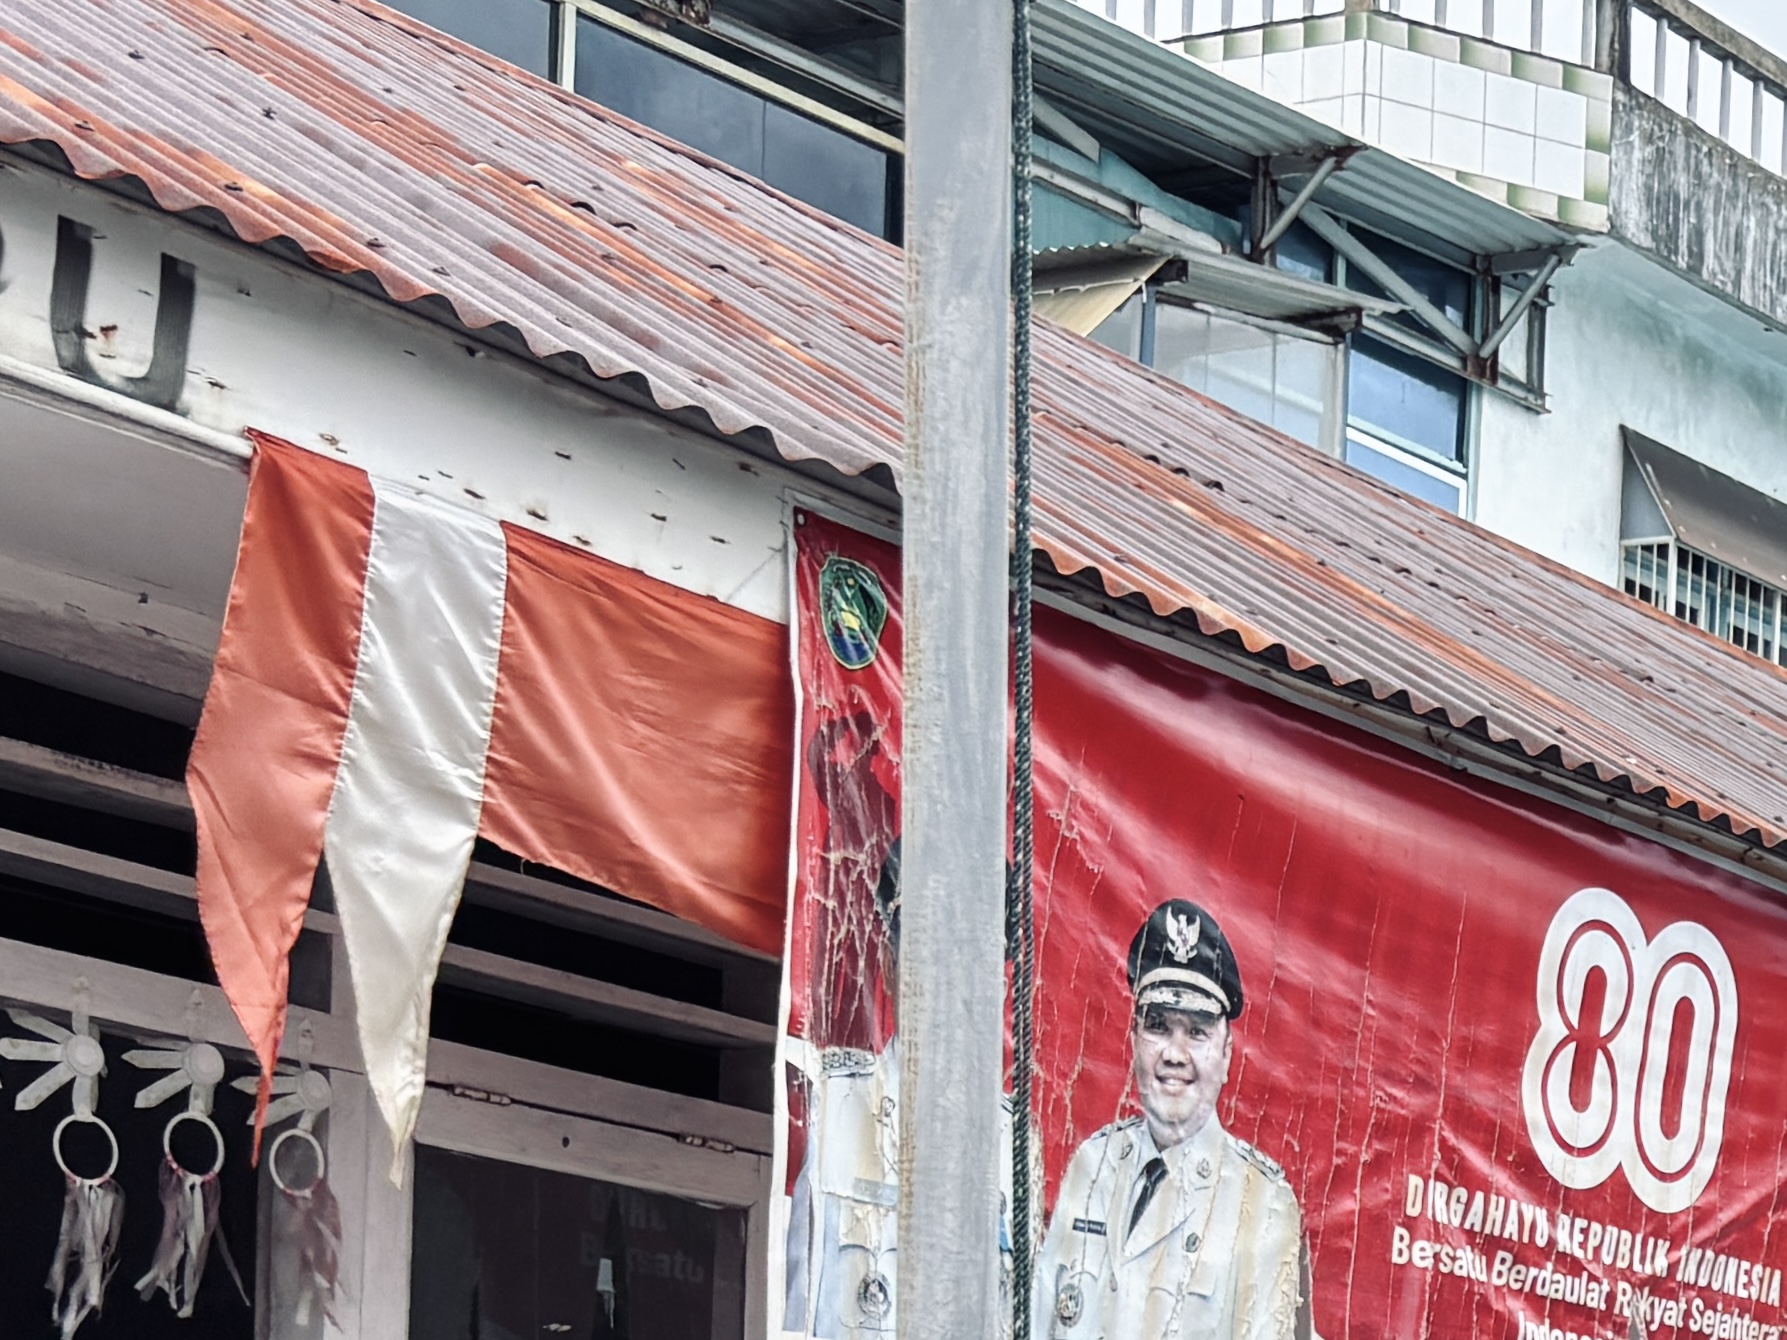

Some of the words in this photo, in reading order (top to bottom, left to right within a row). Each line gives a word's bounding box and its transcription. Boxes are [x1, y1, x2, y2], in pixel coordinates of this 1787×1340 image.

[0, 213, 197, 419] U
[1521, 887, 1739, 1213] 80
[1391, 1226, 1488, 1282] Bersatu
[1492, 1250, 1611, 1312] Berdaulat
[1405, 1173, 1549, 1248] DIRGAHAYU
[1556, 1214, 1671, 1277] REPUBLIK
[1678, 1245, 1782, 1307] INDONESIA
